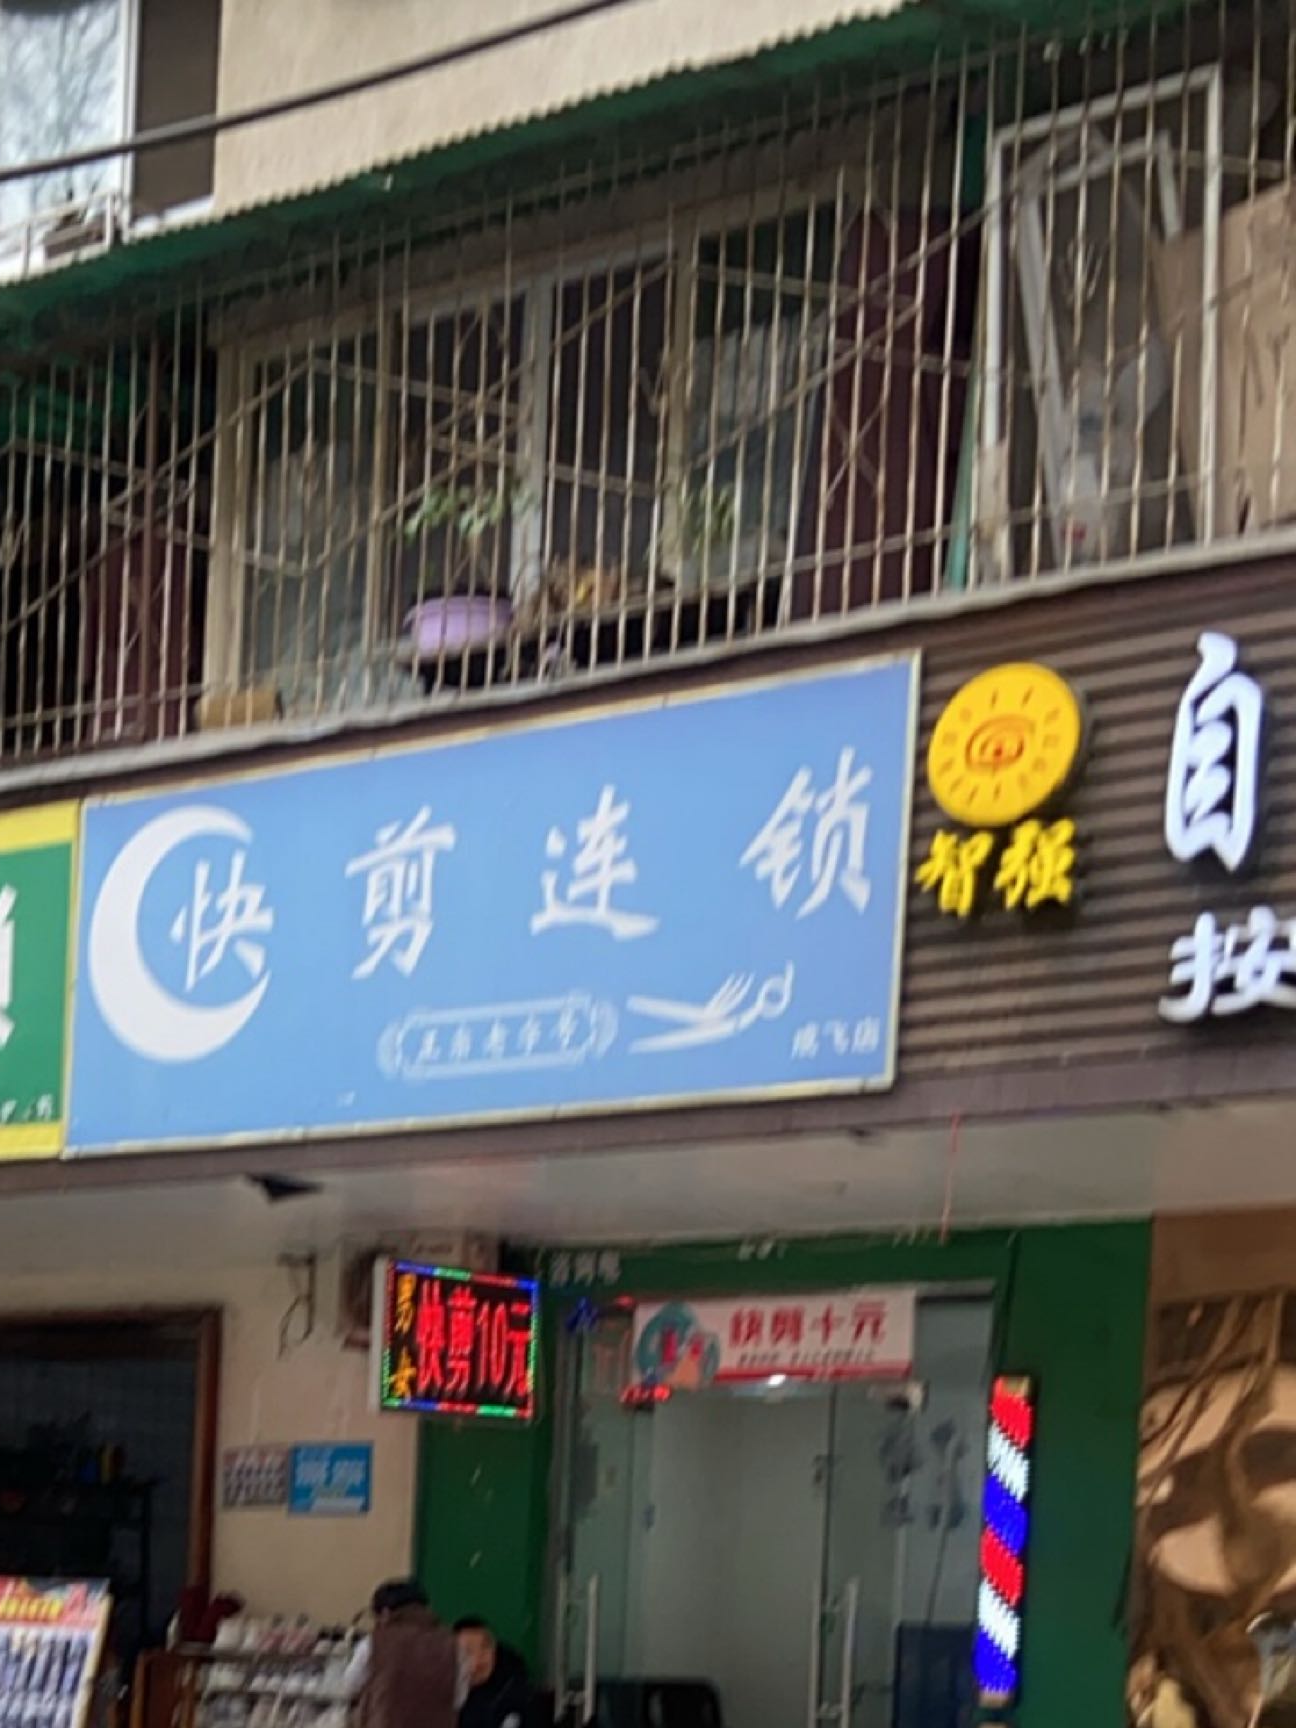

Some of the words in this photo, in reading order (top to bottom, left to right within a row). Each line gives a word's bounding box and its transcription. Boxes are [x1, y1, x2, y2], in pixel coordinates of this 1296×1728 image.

[170, 745, 876, 993] 快剪连锁
[1165, 632, 1263, 872] 自
[415, 1279, 533, 1398] 快剪10元
